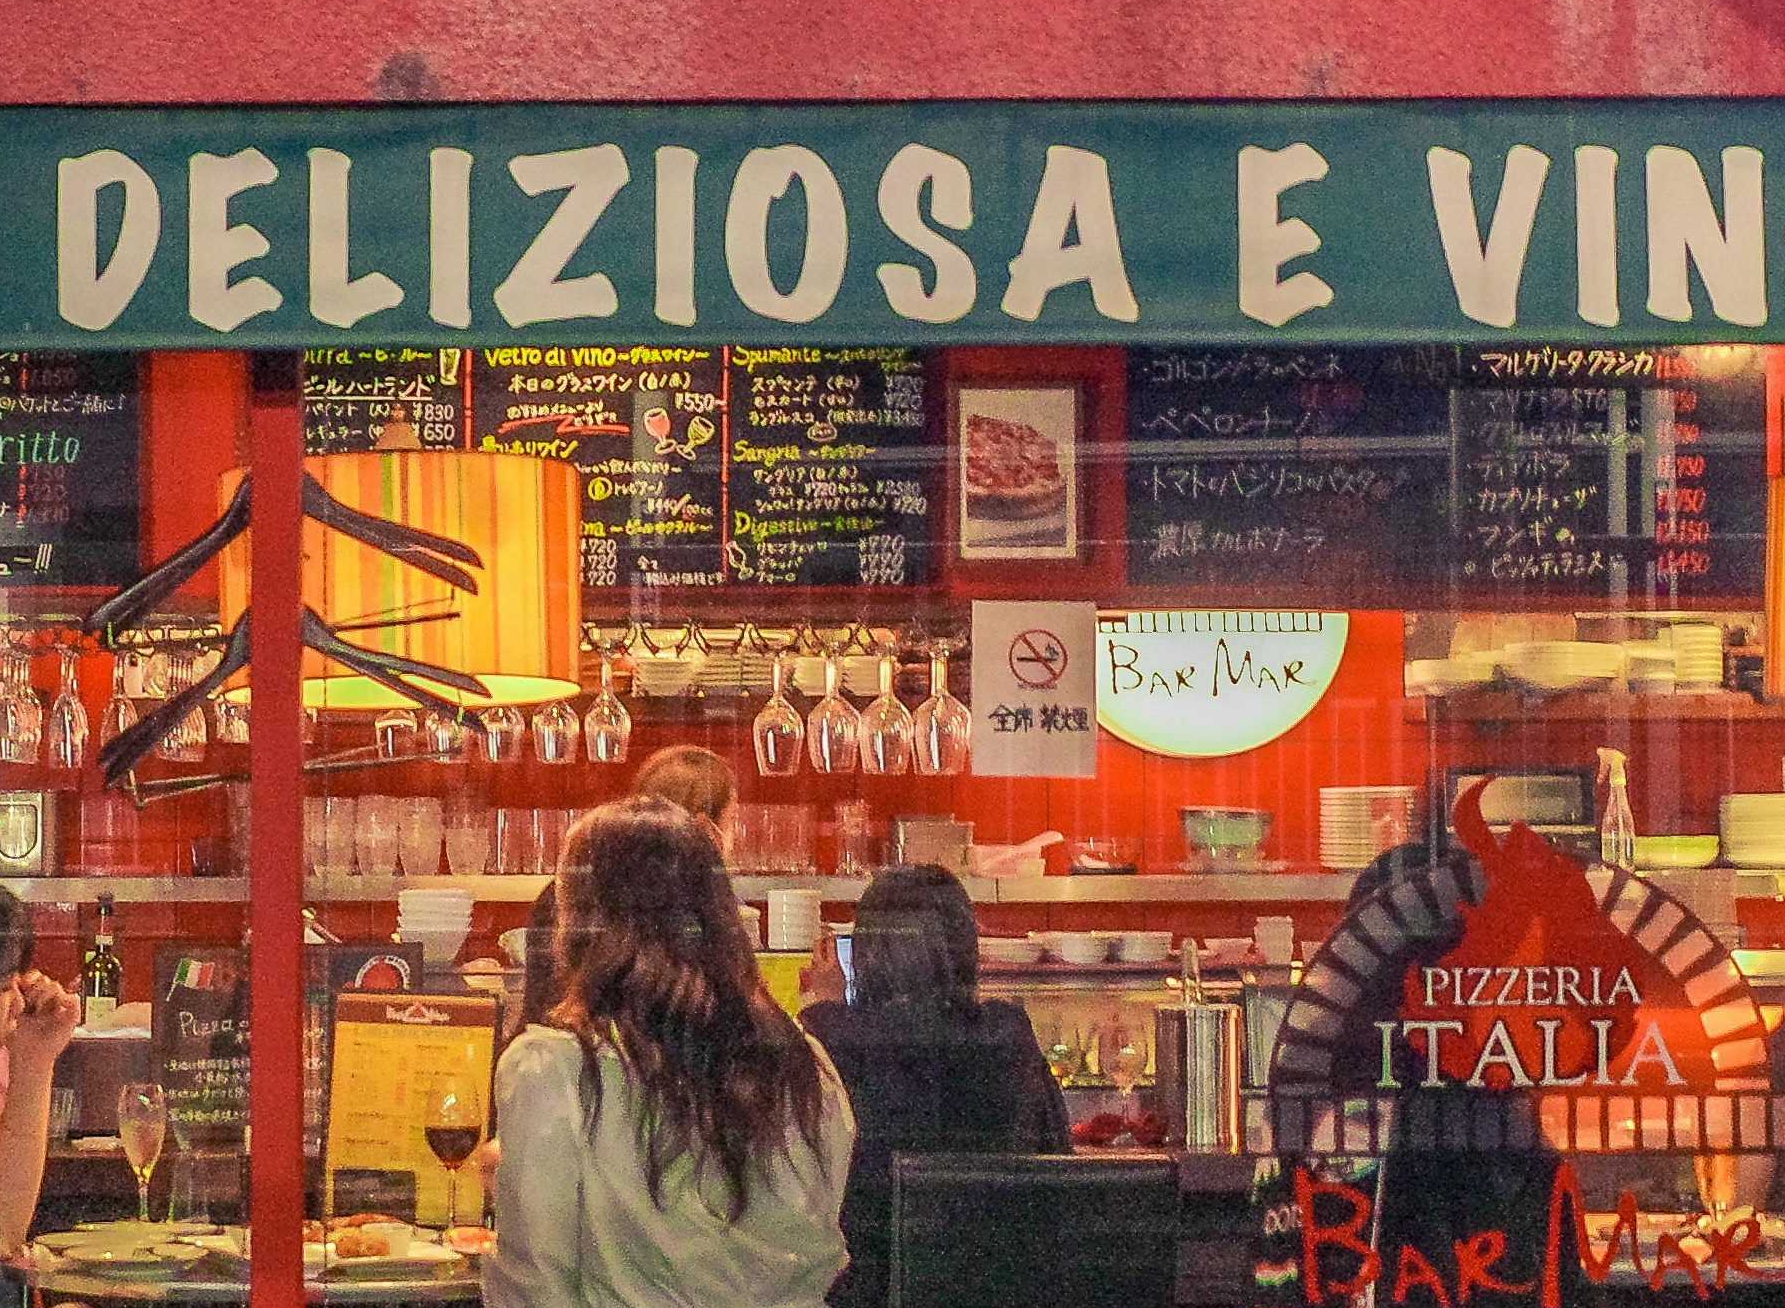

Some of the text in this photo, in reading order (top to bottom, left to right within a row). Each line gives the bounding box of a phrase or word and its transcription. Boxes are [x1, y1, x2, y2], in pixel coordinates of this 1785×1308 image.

[56, 142, 1141, 335] DELIZIOSA
[1236, 141, 1336, 329] E
[1421, 964, 1643, 1009] PIZZERIA
[1372, 1018, 1689, 1090] ITALIA
